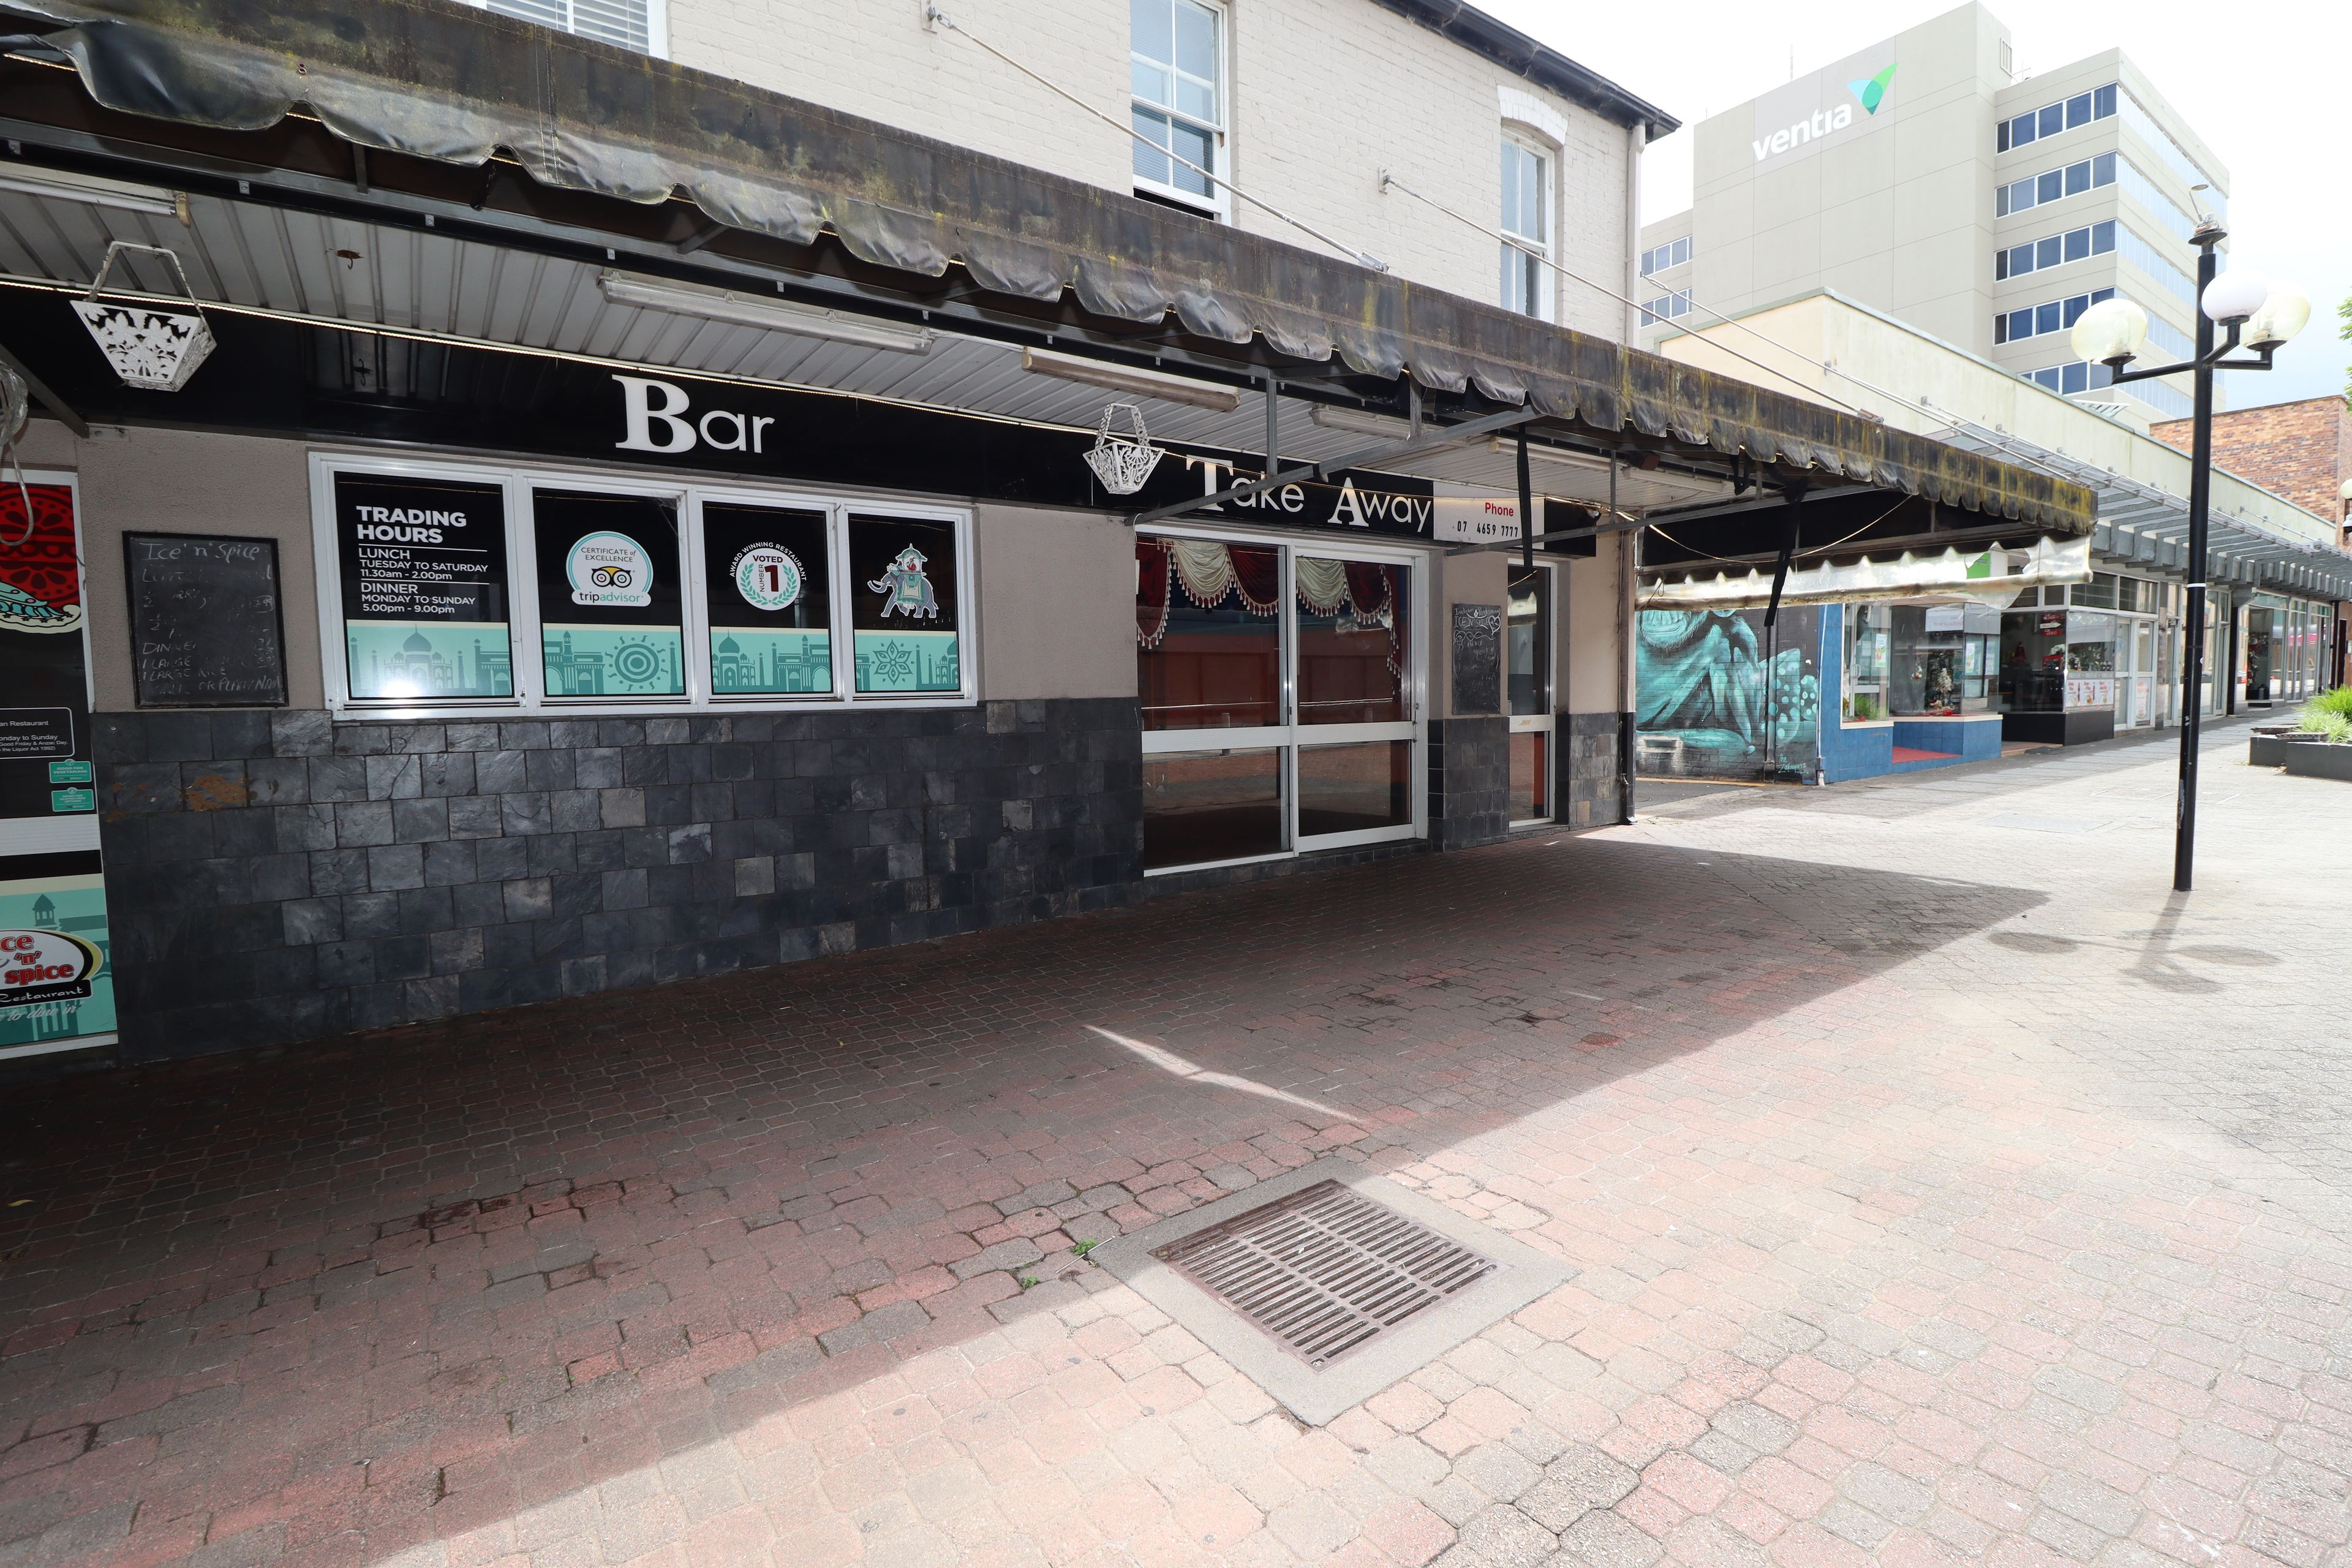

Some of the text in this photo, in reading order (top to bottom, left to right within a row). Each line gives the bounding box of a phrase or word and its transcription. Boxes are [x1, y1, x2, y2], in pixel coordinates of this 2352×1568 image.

[1752, 104, 1852, 161] ventia
[612, 374, 775, 453] Bar
[1186, 454, 1431, 532] Take Away
[356, 505, 467, 527] TRADING
[1485, 502, 1514, 516] Phone
[357, 524, 443, 543] HOURS
[1457, 521, 1518, 537] 07 4659 7777
[139, 543, 181, 560] Ice
[216, 543, 260, 564] Spice
[358, 548, 410, 560] LUNCH
[581, 547, 628, 556] CERTIFICATE
[360, 559, 412, 568] TUESDAY
[432, 562, 488, 572] SATURDAY
[729, 541, 807, 581] AWARD WINNING RESTAURANT
[360, 569, 402, 578] 11.30am
[412, 571, 453, 581] 2.00pm
[764, 565, 779, 592] 1
[361, 582, 418, 594] DINNER
[361, 594, 411, 603] MONDAY
[432, 596, 475, 605] SUNDAY
[579, 591, 641, 603] tripadvisor
[363, 603, 405, 613] 5.00pm
[414, 605, 455, 614] 9.00pm
[4, 963, 75, 986] spice
